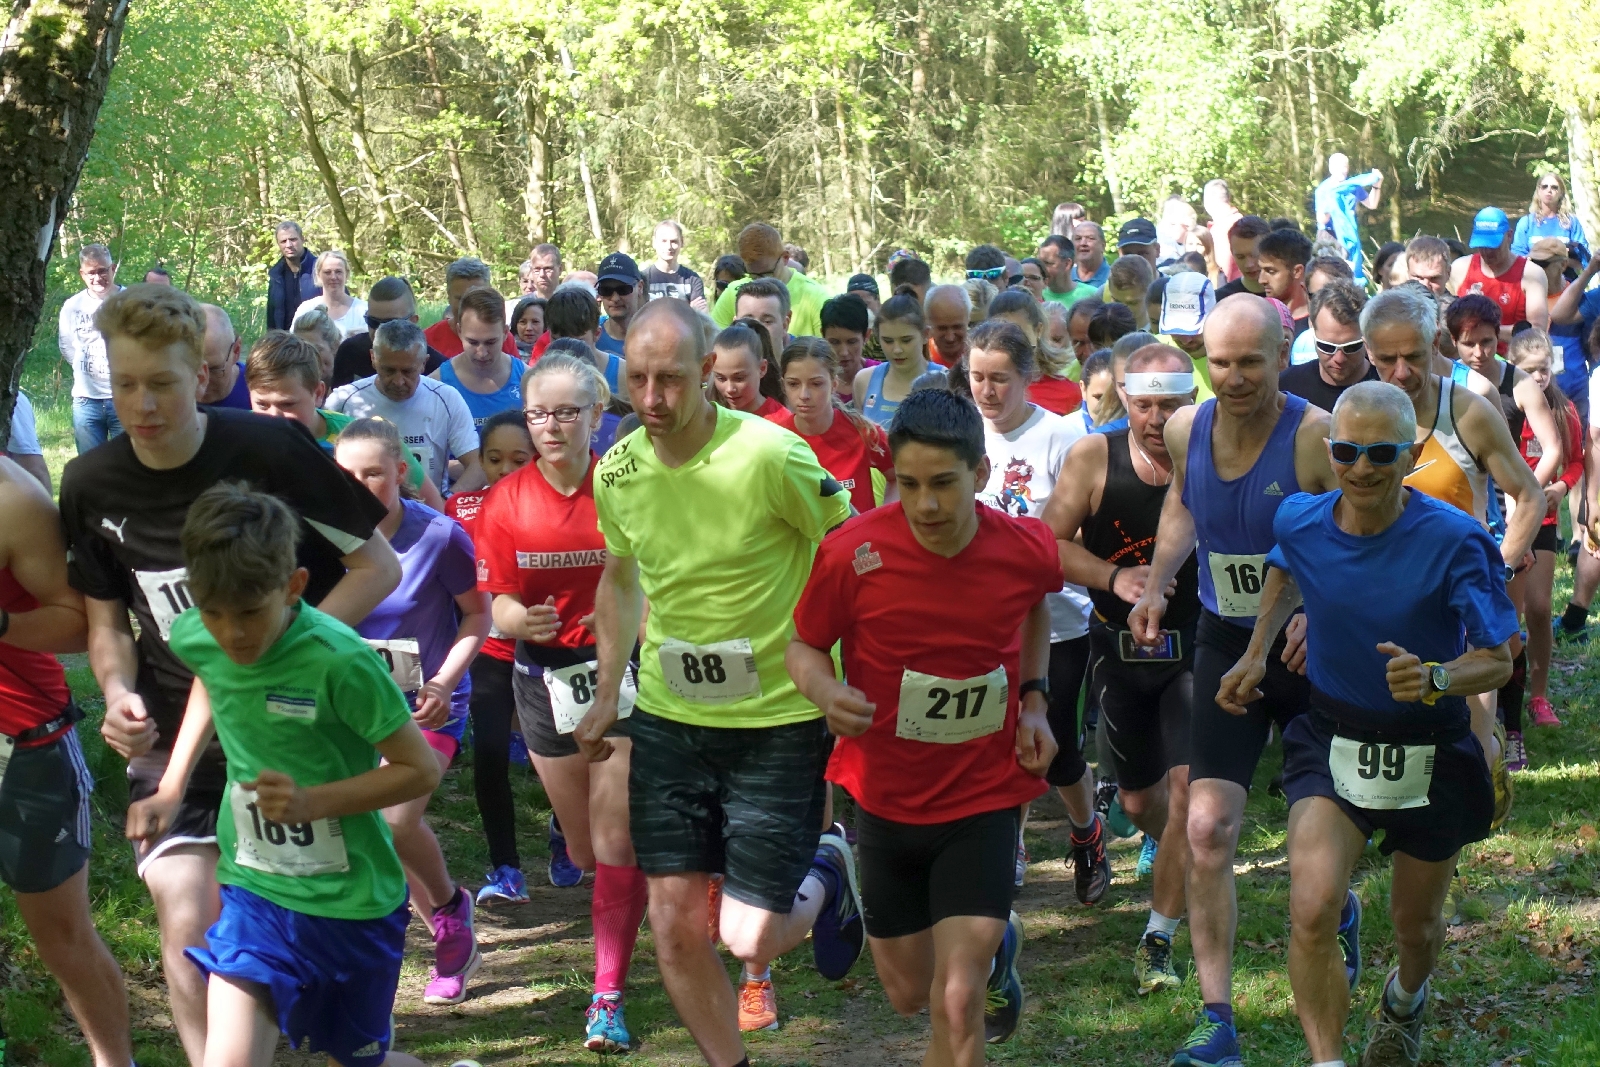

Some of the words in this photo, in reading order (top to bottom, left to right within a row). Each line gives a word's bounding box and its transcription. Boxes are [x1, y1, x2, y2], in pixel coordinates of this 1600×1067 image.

[1169, 302, 1196, 310] ERDINGER
[456, 507, 480, 519] Spor
[1224, 563, 1269, 595] 16
[681, 652, 726, 684] 88
[925, 685, 988, 719] 217
[1357, 743, 1406, 782] 99
